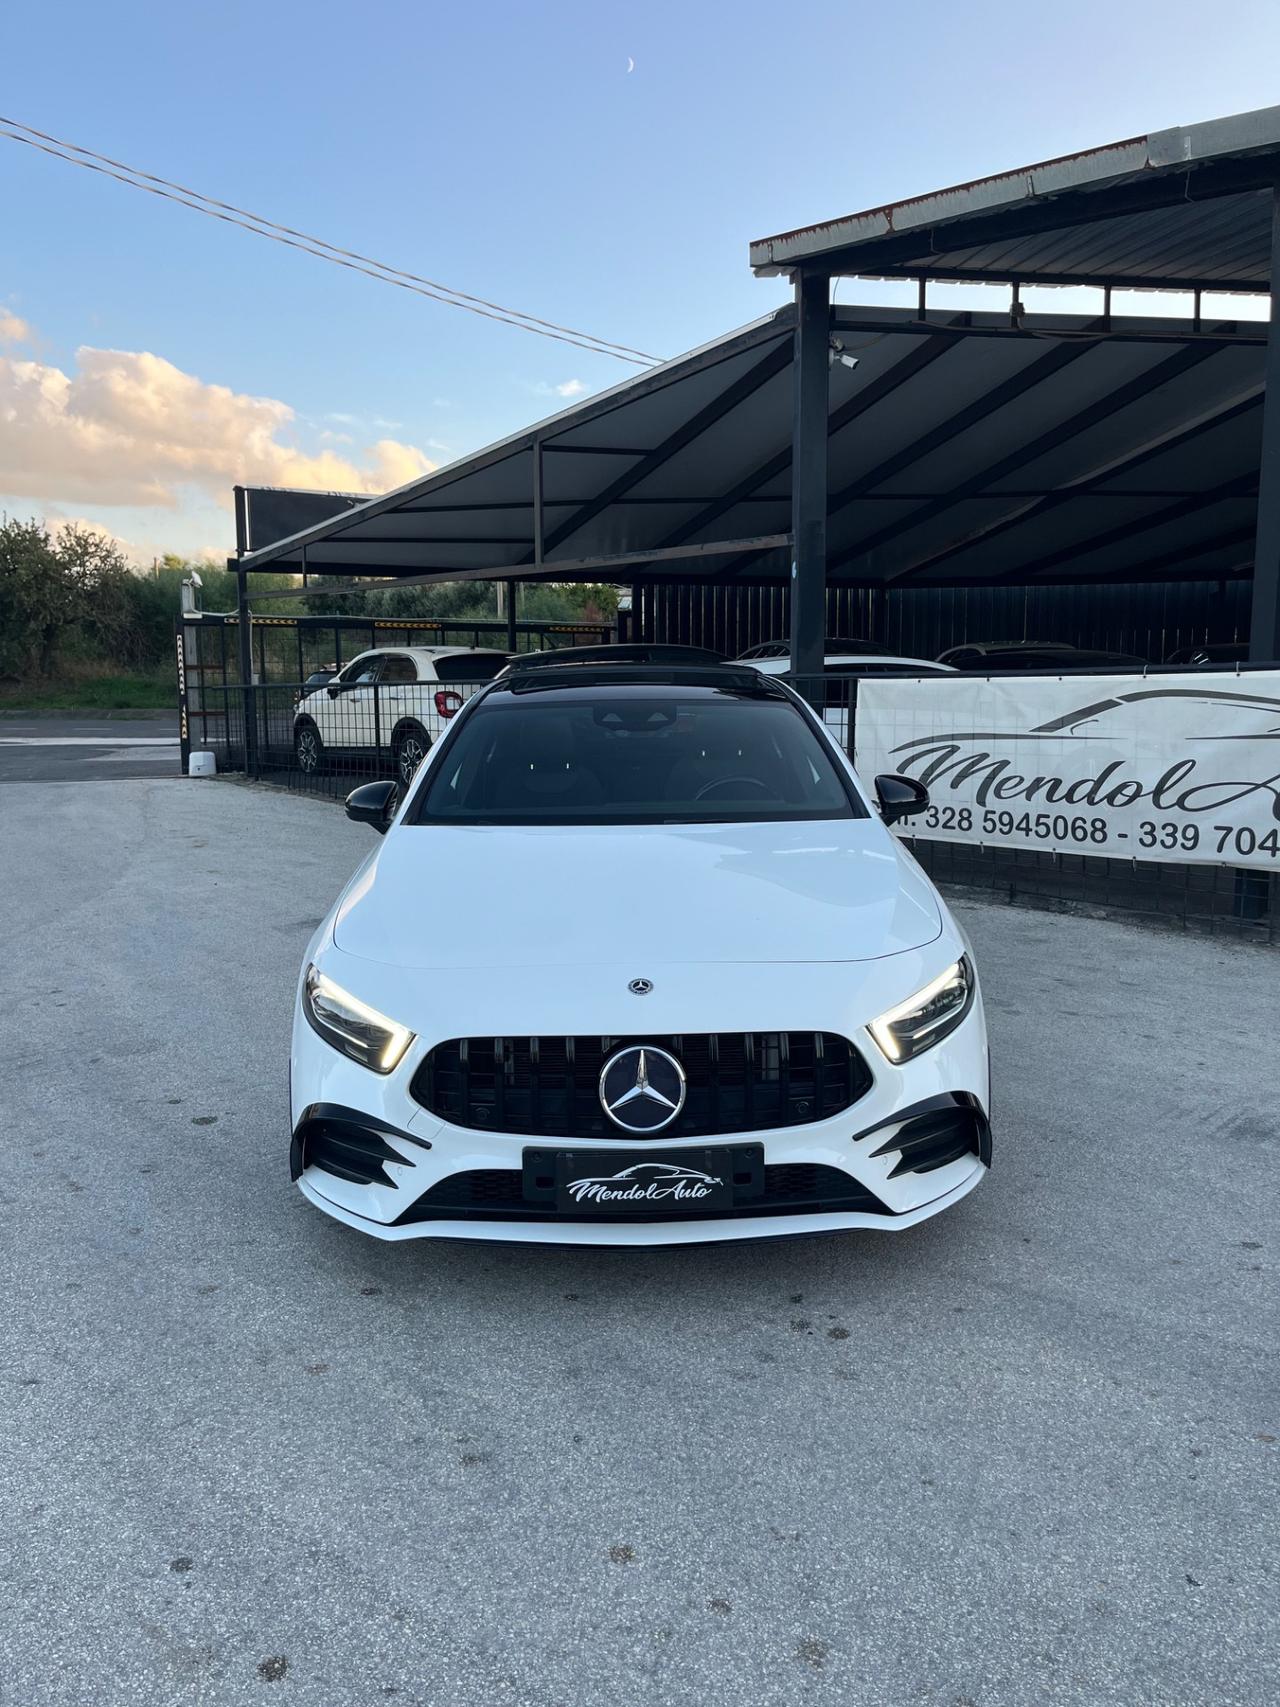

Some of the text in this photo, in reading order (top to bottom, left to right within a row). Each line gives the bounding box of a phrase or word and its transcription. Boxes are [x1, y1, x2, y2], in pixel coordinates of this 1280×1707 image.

[926, 805, 973, 832] 328
[983, 810, 1108, 844] 5945068
[1139, 821, 1200, 851] 339
[1213, 825, 1280, 858] 704
[567, 1180, 712, 1203] MendolAuto
